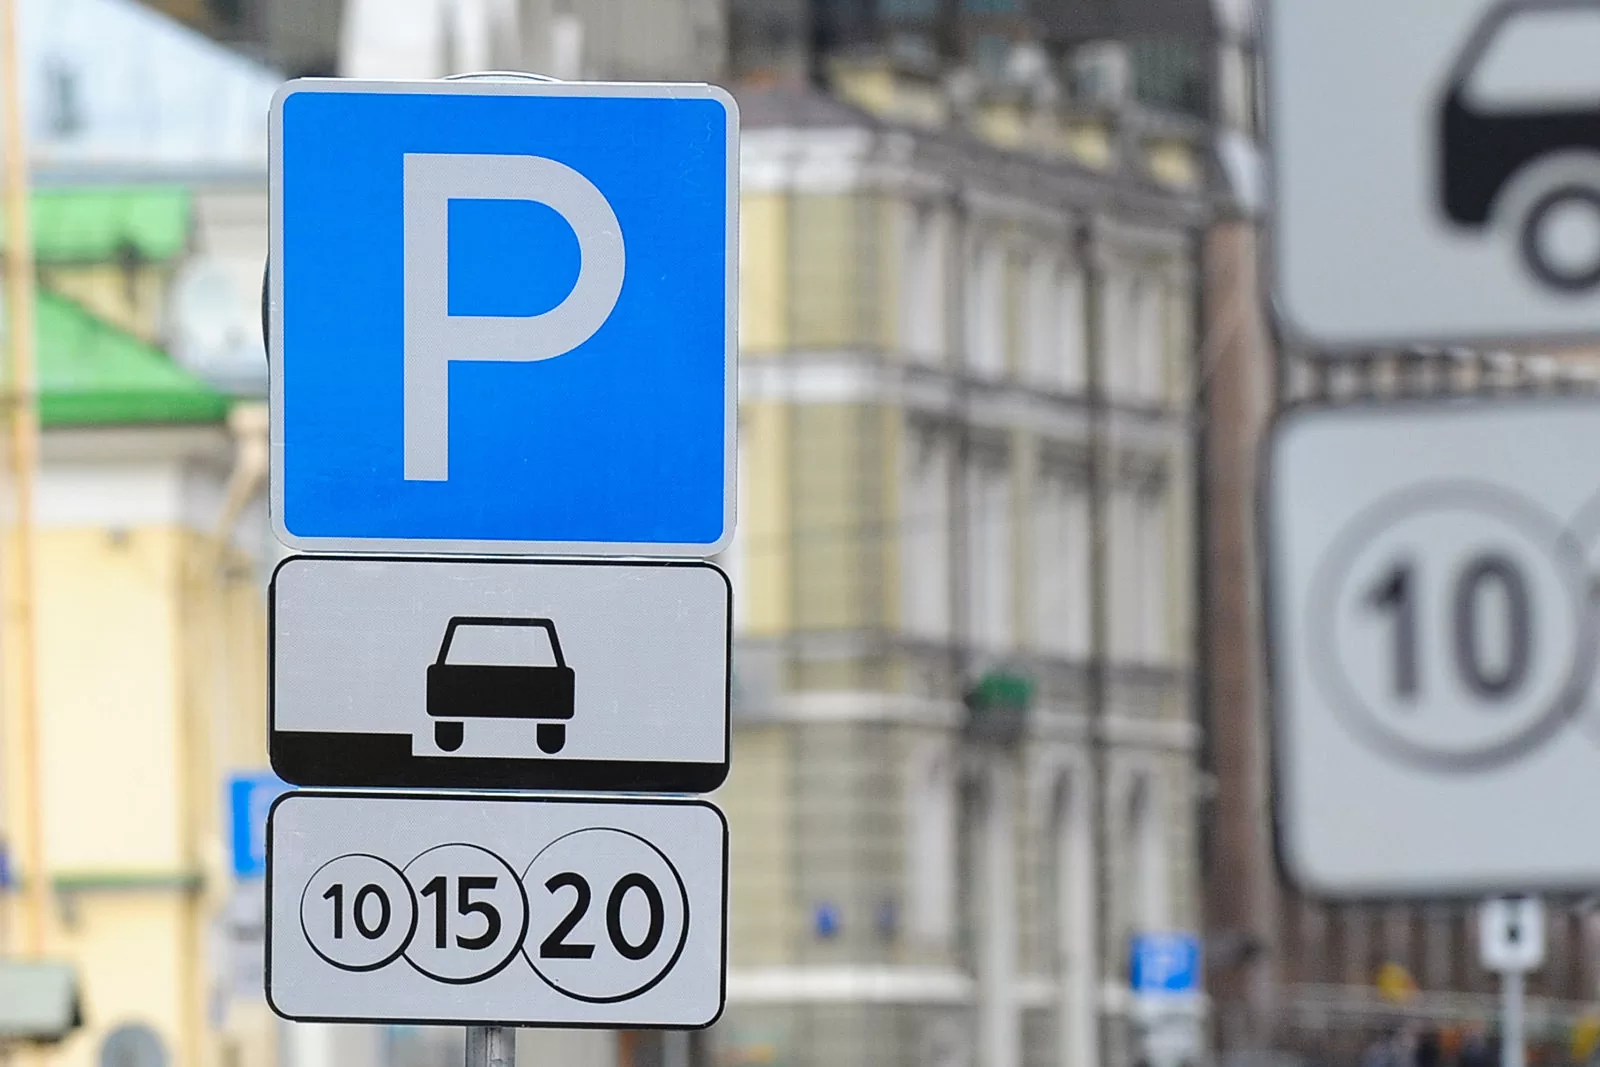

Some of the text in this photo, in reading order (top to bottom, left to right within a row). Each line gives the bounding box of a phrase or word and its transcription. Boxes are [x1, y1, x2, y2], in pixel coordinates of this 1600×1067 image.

[404, 152, 626, 481] P
[1359, 548, 1537, 705] 10
[322, 872, 664, 961] 10 15 20
